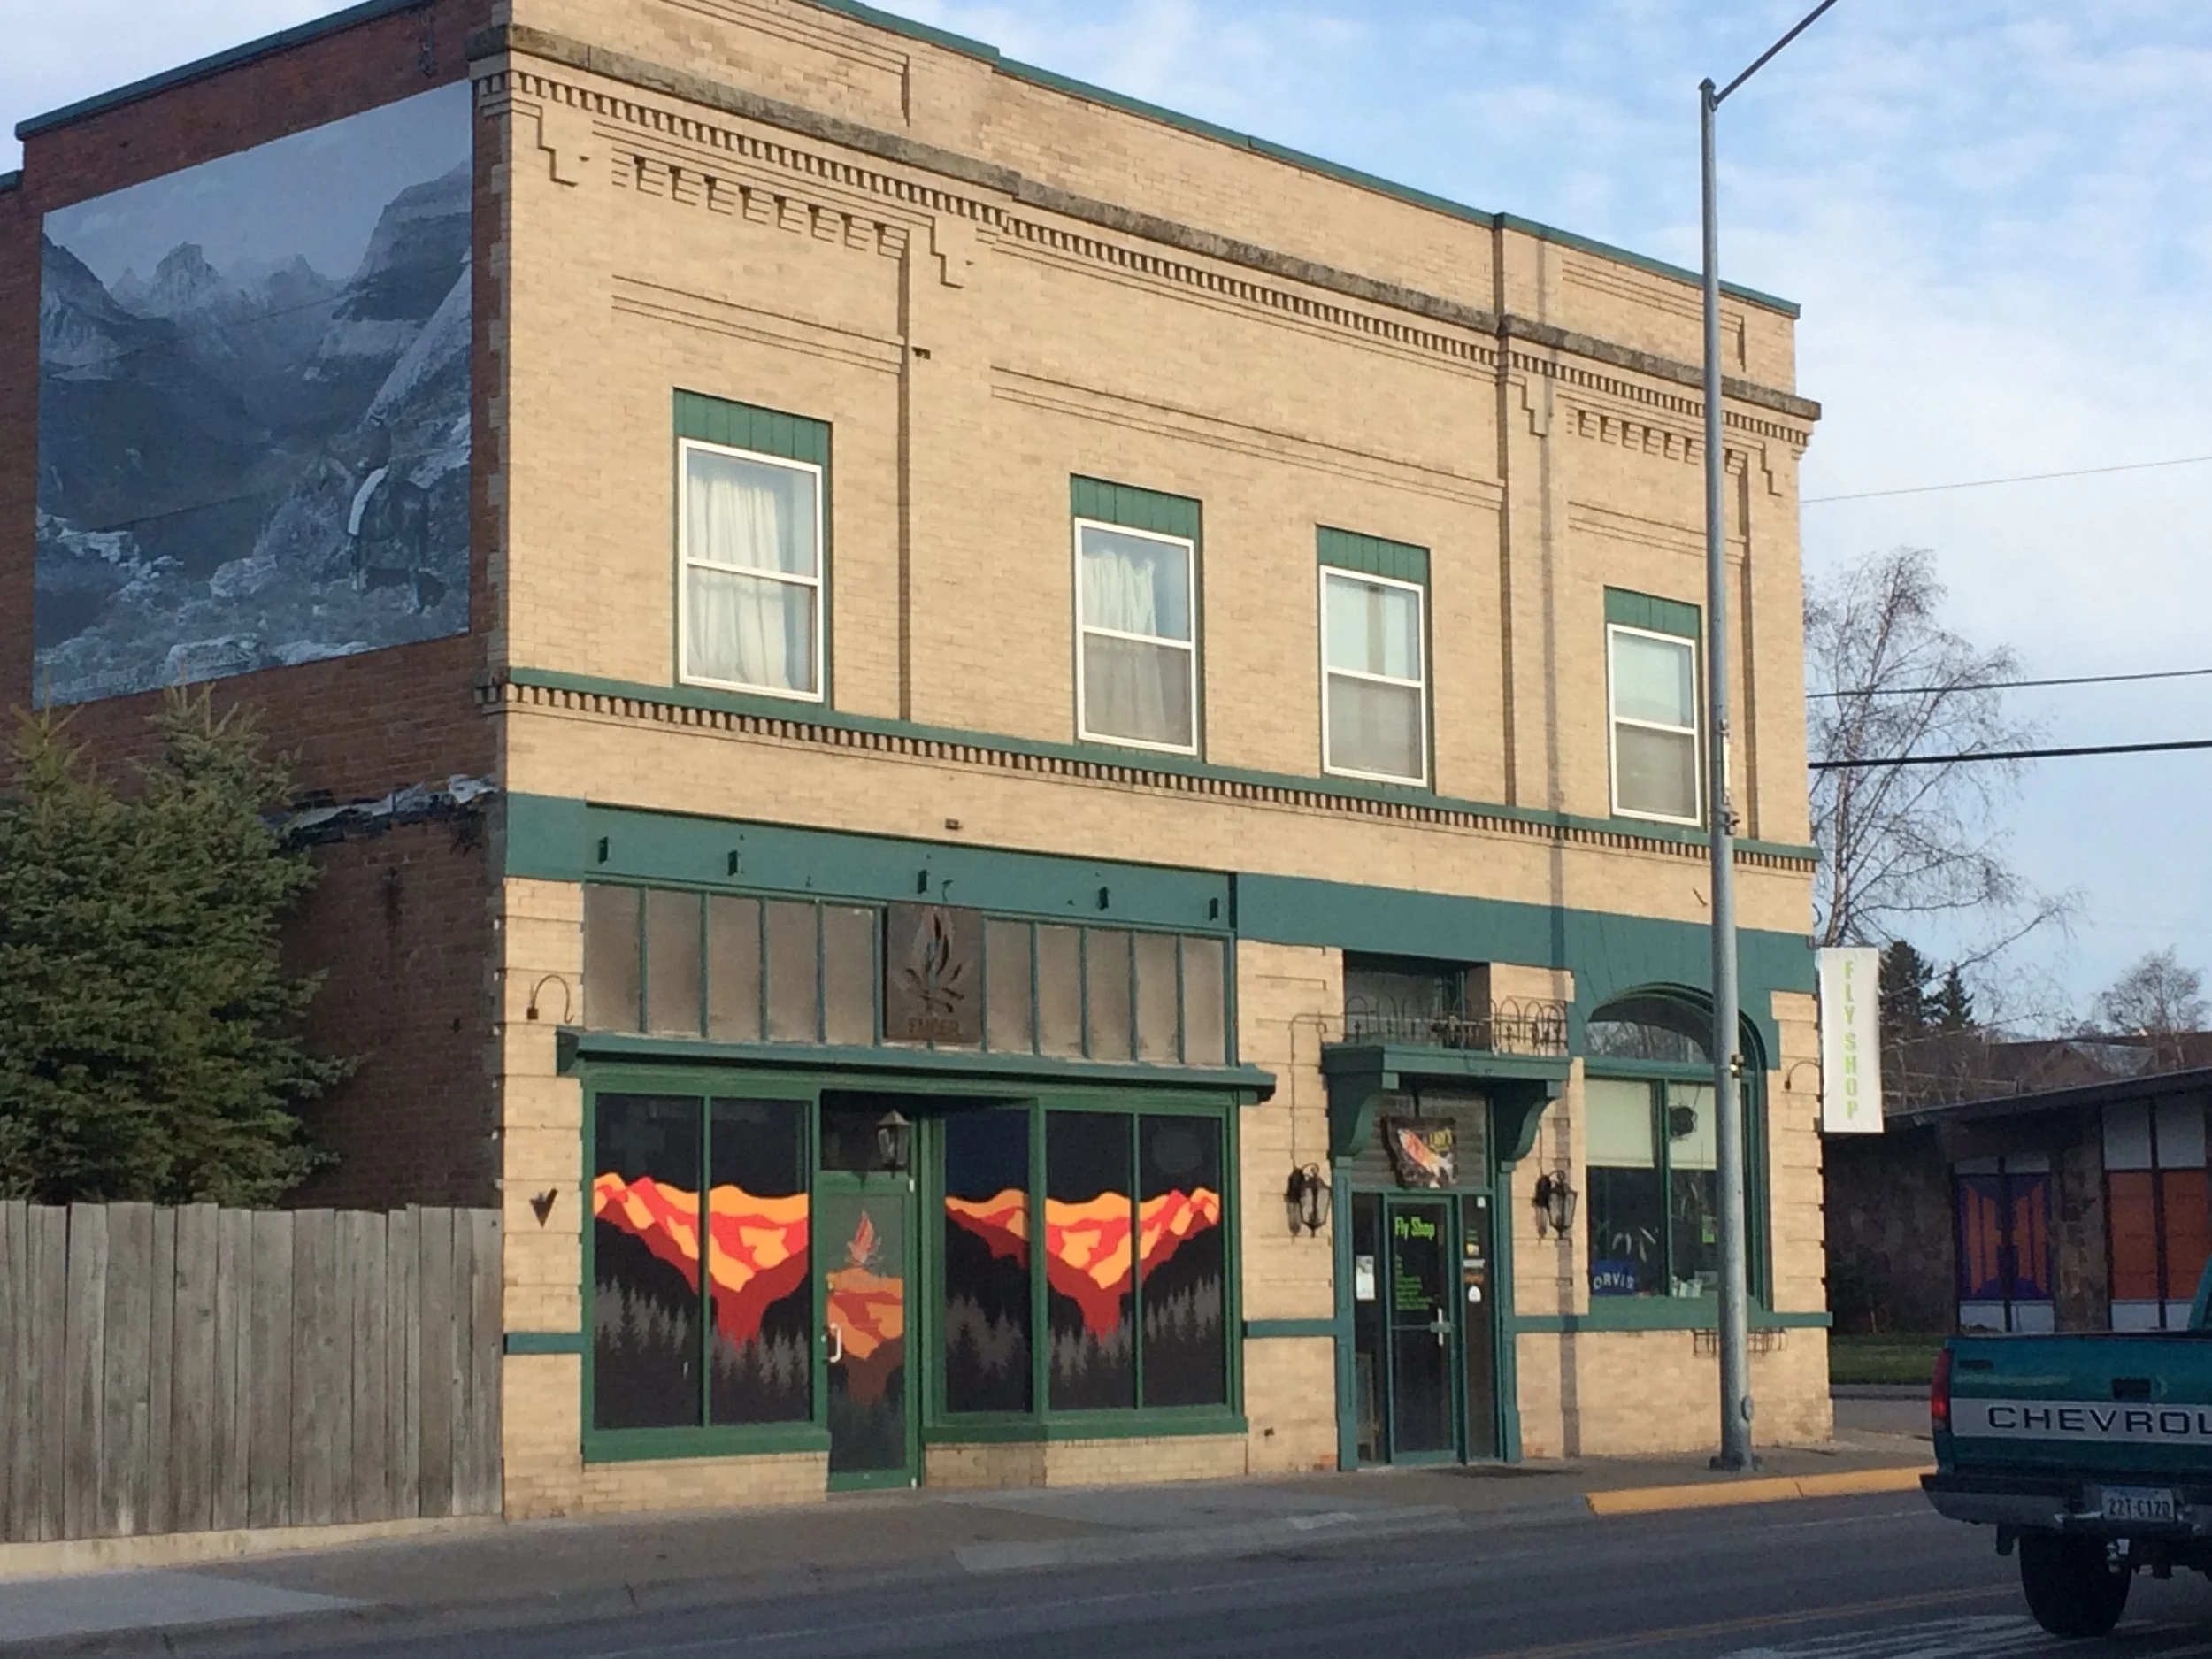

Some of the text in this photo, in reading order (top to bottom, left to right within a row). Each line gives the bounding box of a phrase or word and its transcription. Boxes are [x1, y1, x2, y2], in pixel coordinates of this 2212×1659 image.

[1845, 1033, 1858, 1119] SHOP
[1394, 1217, 1409, 1240] Fly
[1594, 1271, 1634, 1290] ORVIS
[1988, 1406, 2212, 1435] CHEVROL
